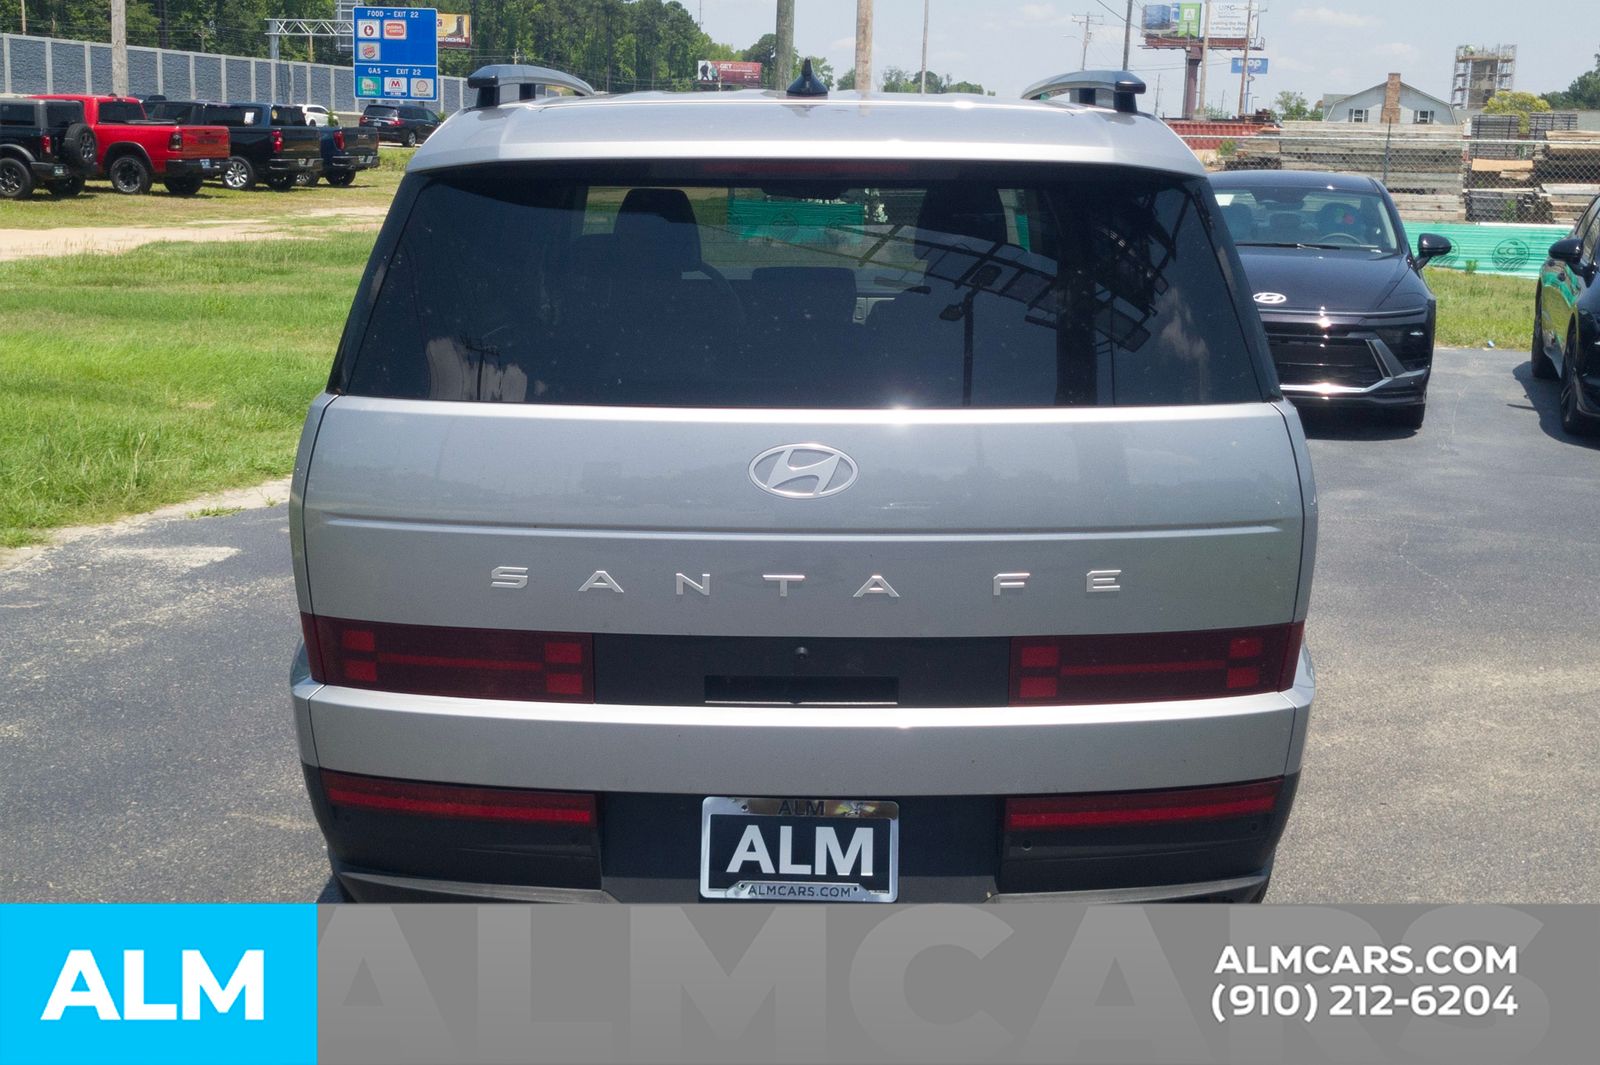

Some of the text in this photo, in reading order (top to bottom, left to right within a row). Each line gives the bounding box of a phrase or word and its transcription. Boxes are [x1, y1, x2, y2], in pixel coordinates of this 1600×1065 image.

[491, 566, 1121, 598] SANTA FE
[778, 800, 825, 816] ALM
[726, 824, 874, 877] ALM
[747, 884, 851, 898] ALMCARS.COM
